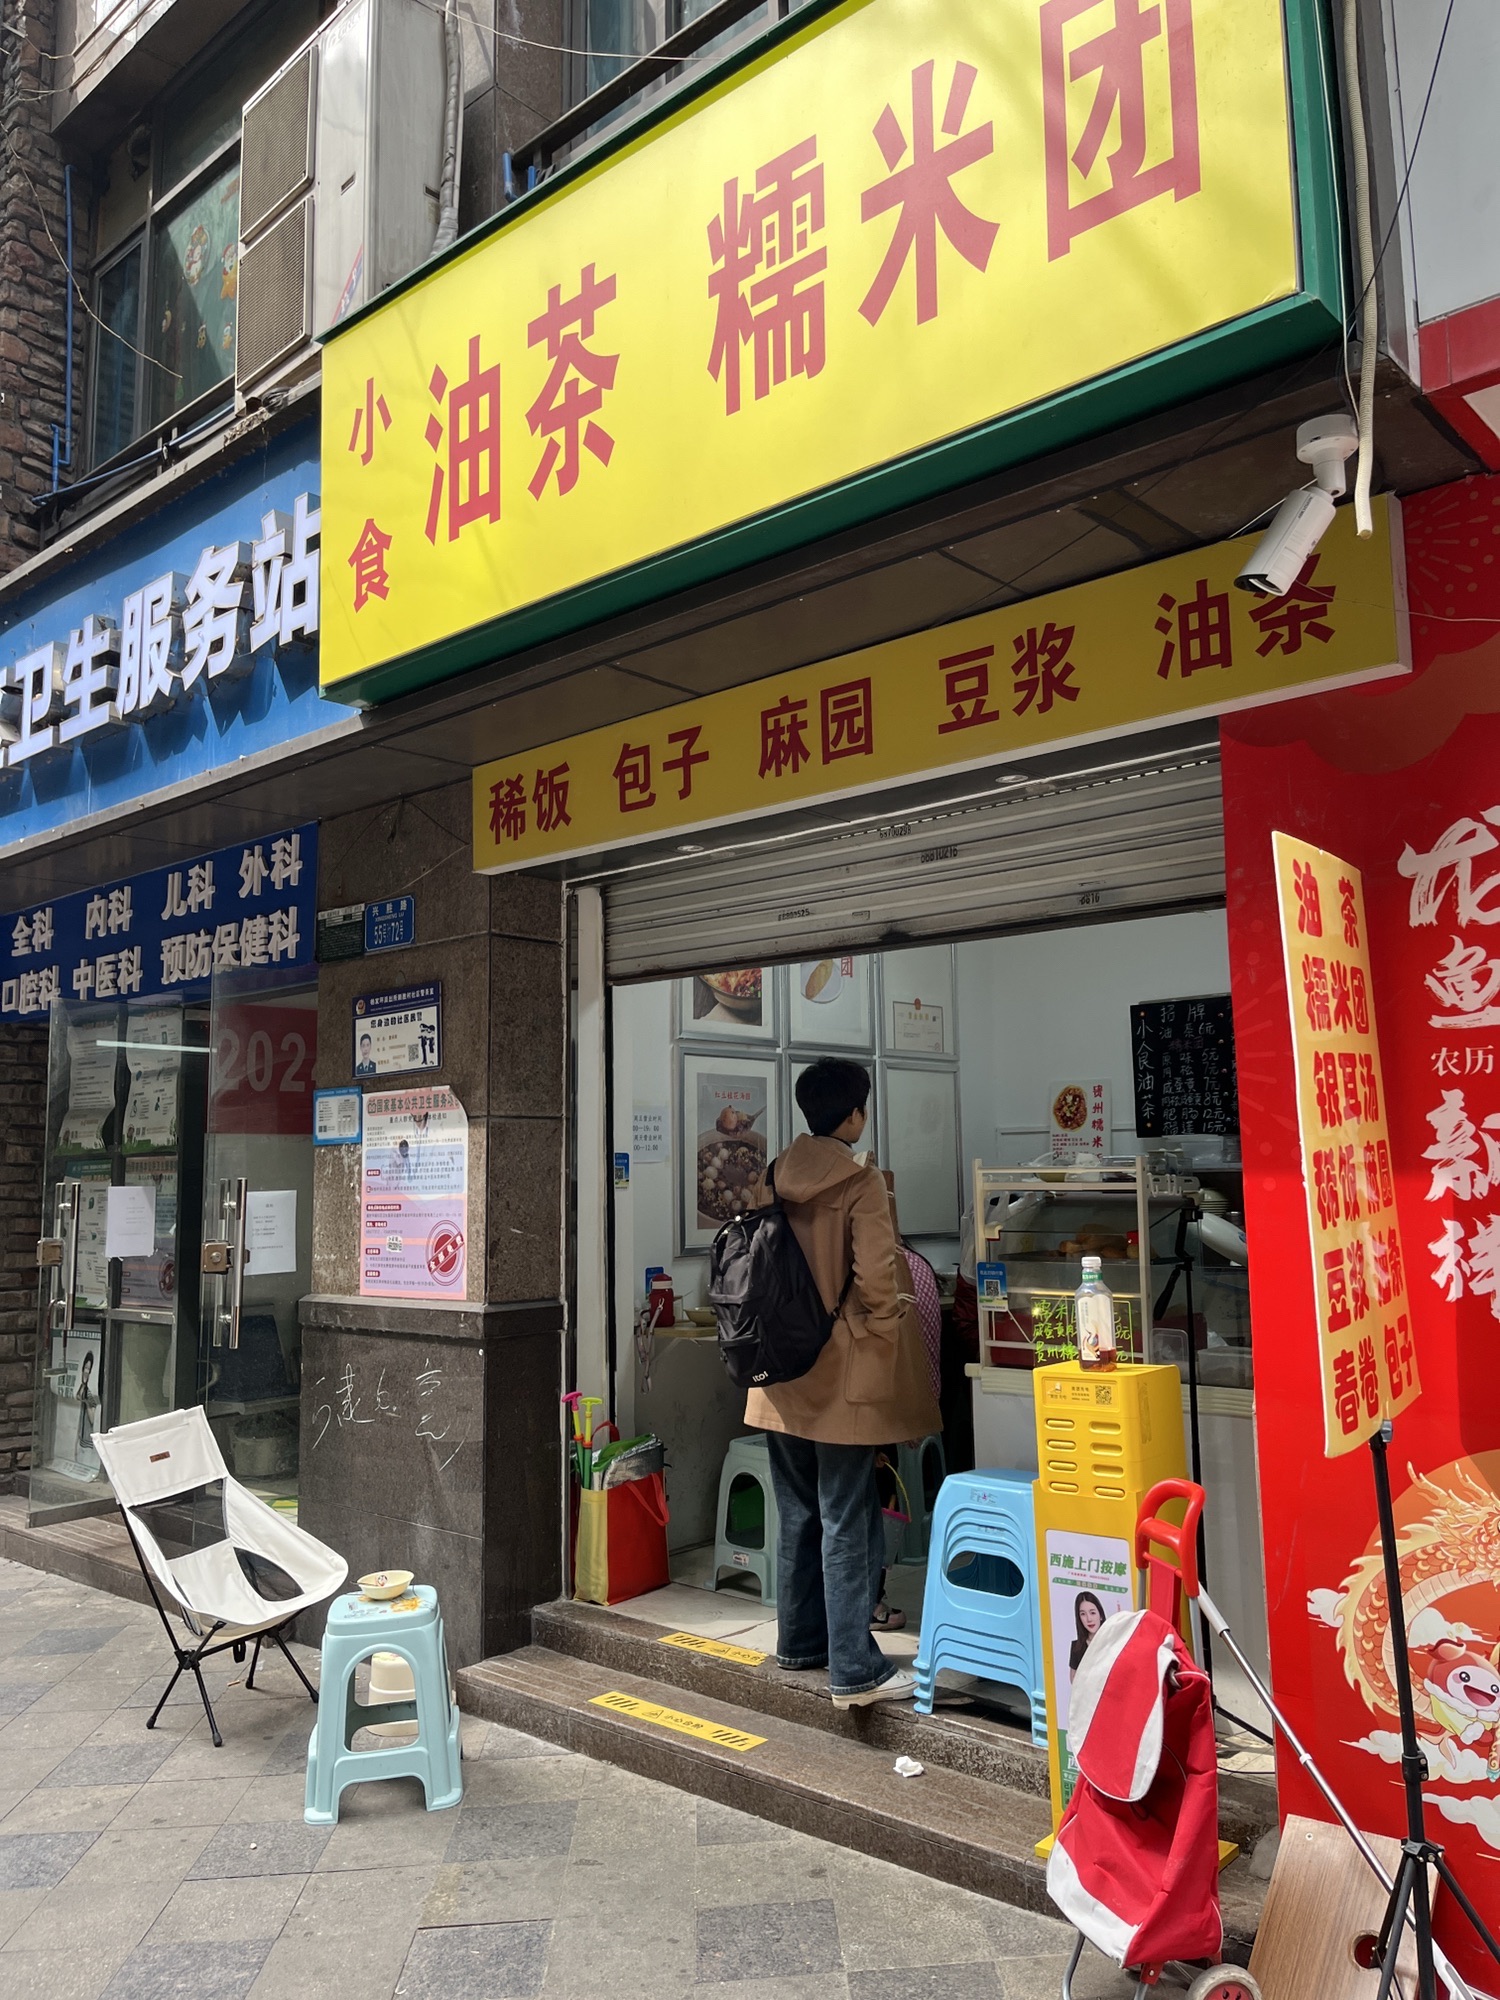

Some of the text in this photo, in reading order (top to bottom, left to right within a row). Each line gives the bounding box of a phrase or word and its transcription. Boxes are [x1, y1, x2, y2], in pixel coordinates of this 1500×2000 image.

[424, 0, 1202, 546] 油茶 糯米团
[348, 376, 393, 613] 小食
[0, 492, 320, 768] 卫生服务站
[488, 553, 1337, 846] 稀饭 包子 麻园 豆浆 油条
[11, 833, 303, 957] 全科 内科 儿科 外科
[1292, 858, 1360, 948] 油茶
[1, 964, 61, 1014] 口腔科
[72, 946, 143, 1000] 中医科
[160, 906, 300, 985] 预防保健科
[1302, 953, 1370, 1034] 糯米团
[1160, 1003, 1206, 1023] 招牌
[213, 1028, 319, 1093] 202
[1136, 1019, 1155, 1119] 小食油茶
[1313, 1050, 1379, 1129] 银耳汤
[1430, 1045, 1494, 1077] 农历
[1091, 1084, 1104, 1159] 贵州糯米
[1313, 1143, 1360, 1230] 稀饭
[1323, 1240, 1369, 1333] 豆浆
[1333, 1313, 1413, 1436] 春卷 包子
[1049, 1552, 1128, 1577] 西施上门按摩
